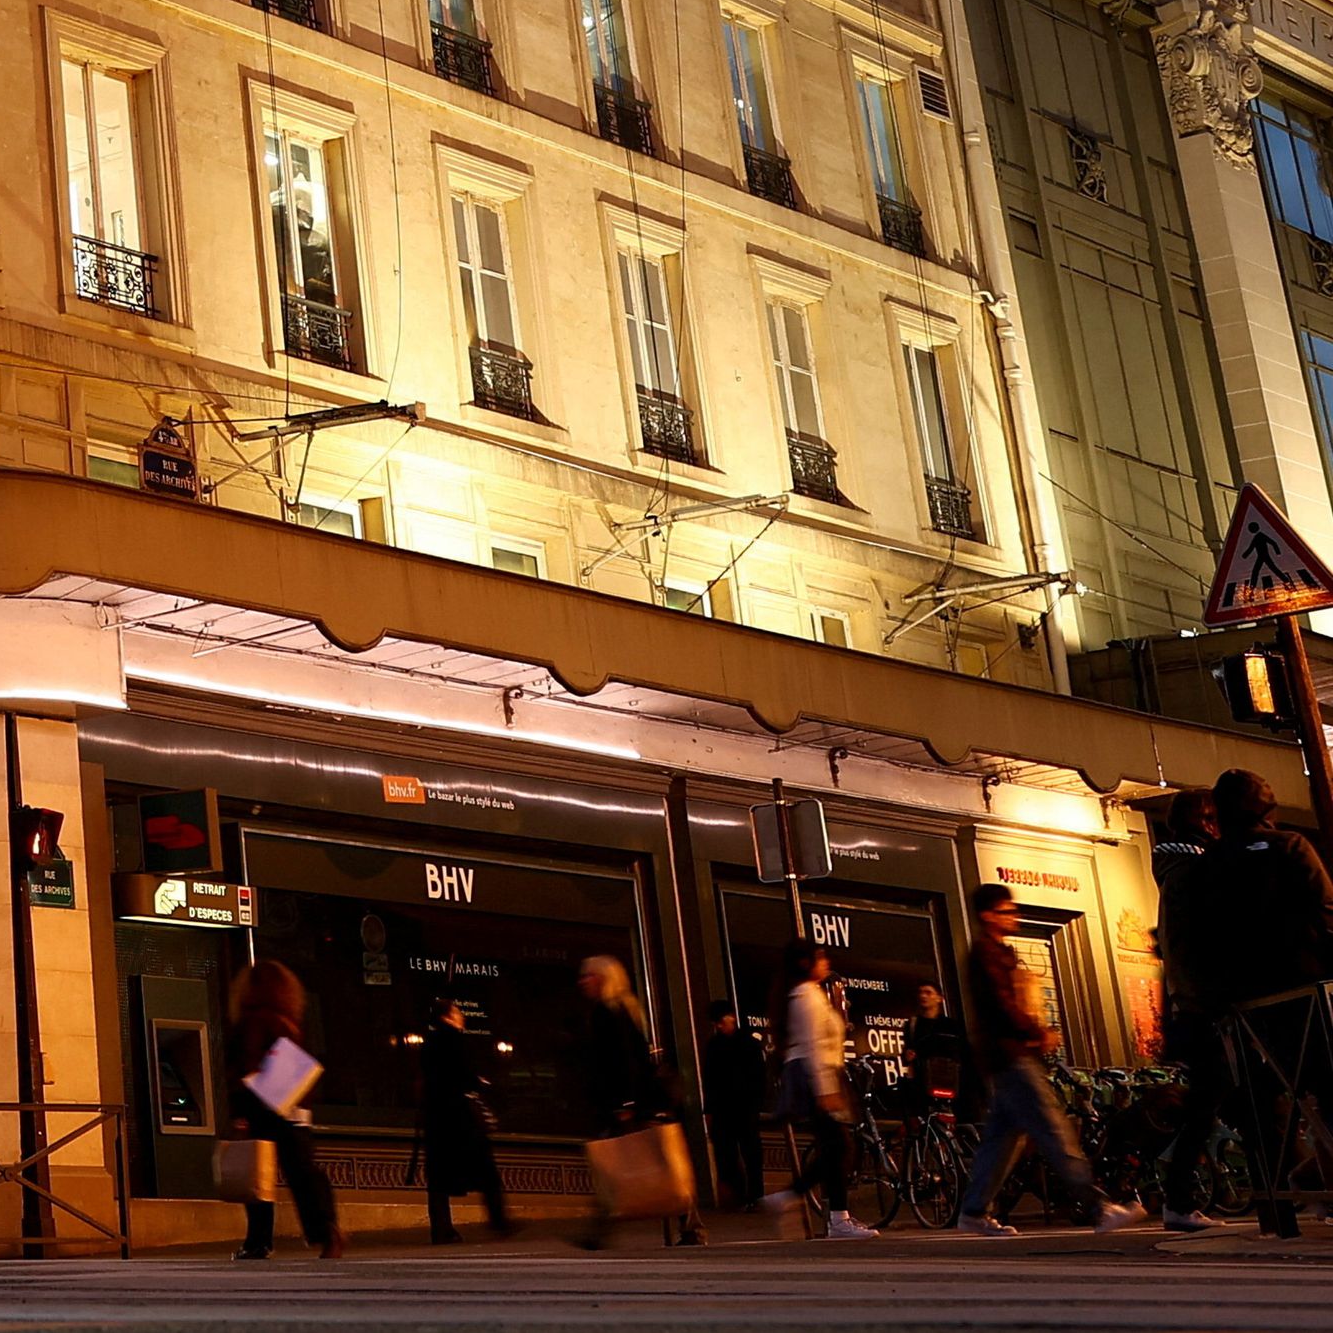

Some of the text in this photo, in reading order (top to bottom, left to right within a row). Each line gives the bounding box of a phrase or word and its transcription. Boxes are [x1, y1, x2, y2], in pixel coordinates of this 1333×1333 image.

[162, 459, 179, 473] RUE
[145, 470, 196, 492] DES ARCHIVES
[388, 781, 417, 799] bhv.fr
[428, 789, 515, 810] Le bazar le plus stylé du web
[44, 870, 56, 881] RUE
[425, 862, 474, 903] BHV
[30, 883, 71, 897] DES ARCHIVES
[192, 881, 227, 897] RETRAIT
[811, 912, 850, 949] BHV
[409, 957, 499, 977] LE BHV MARAIS
[848, 977, 885, 992] NOVEMBRE
[865, 1015, 873, 1026] LE
[883, 1055, 910, 1087] BH
